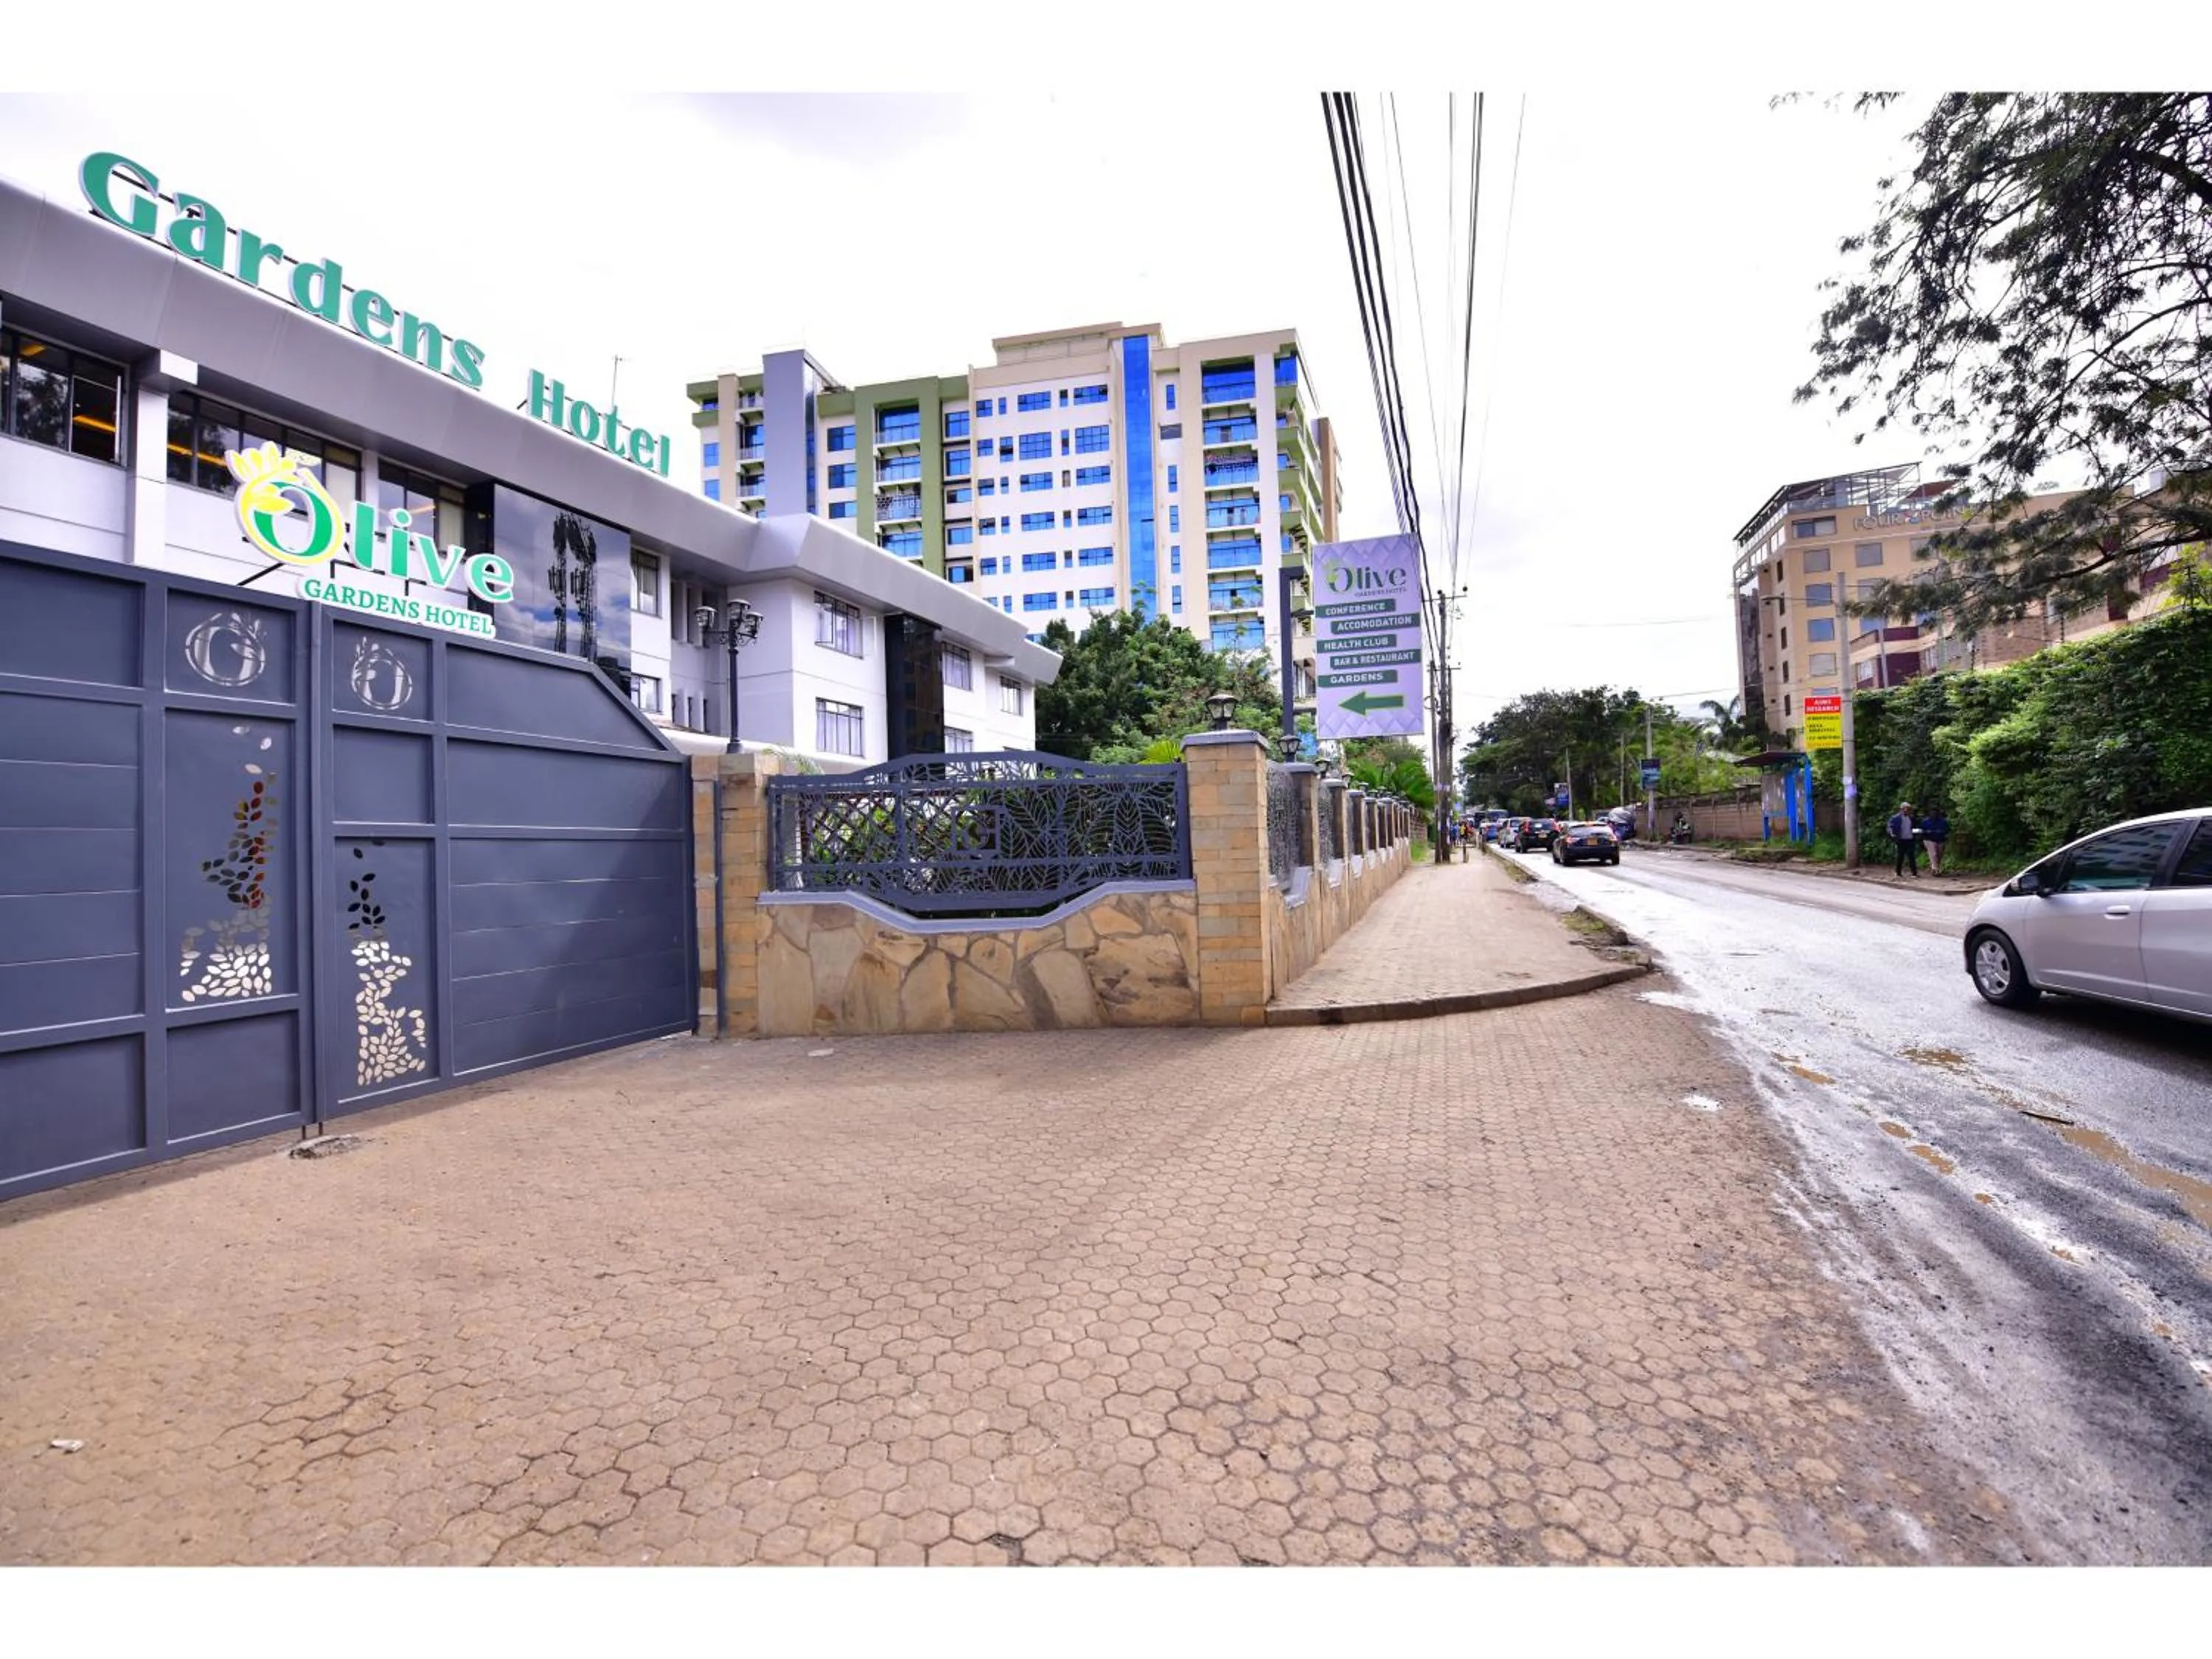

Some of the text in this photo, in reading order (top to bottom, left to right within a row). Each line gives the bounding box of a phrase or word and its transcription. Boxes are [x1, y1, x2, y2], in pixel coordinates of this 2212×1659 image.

[79, 151, 669, 478] Gardens Hotel
[247, 476, 515, 602] Olive
[1328, 566, 1407, 593] Olive
[304, 579, 492, 635] GARDENS HOTEL
[1325, 602, 1386, 616] CONFERENCE
[1337, 616, 1412, 631] ACCOMODATION
[1324, 636, 1388, 650] HEALTH CLUB
[1334, 657, 1351, 666] BAR
[1360, 651, 1414, 663] RESTAURANT
[1330, 672, 1384, 684] GARDENS
